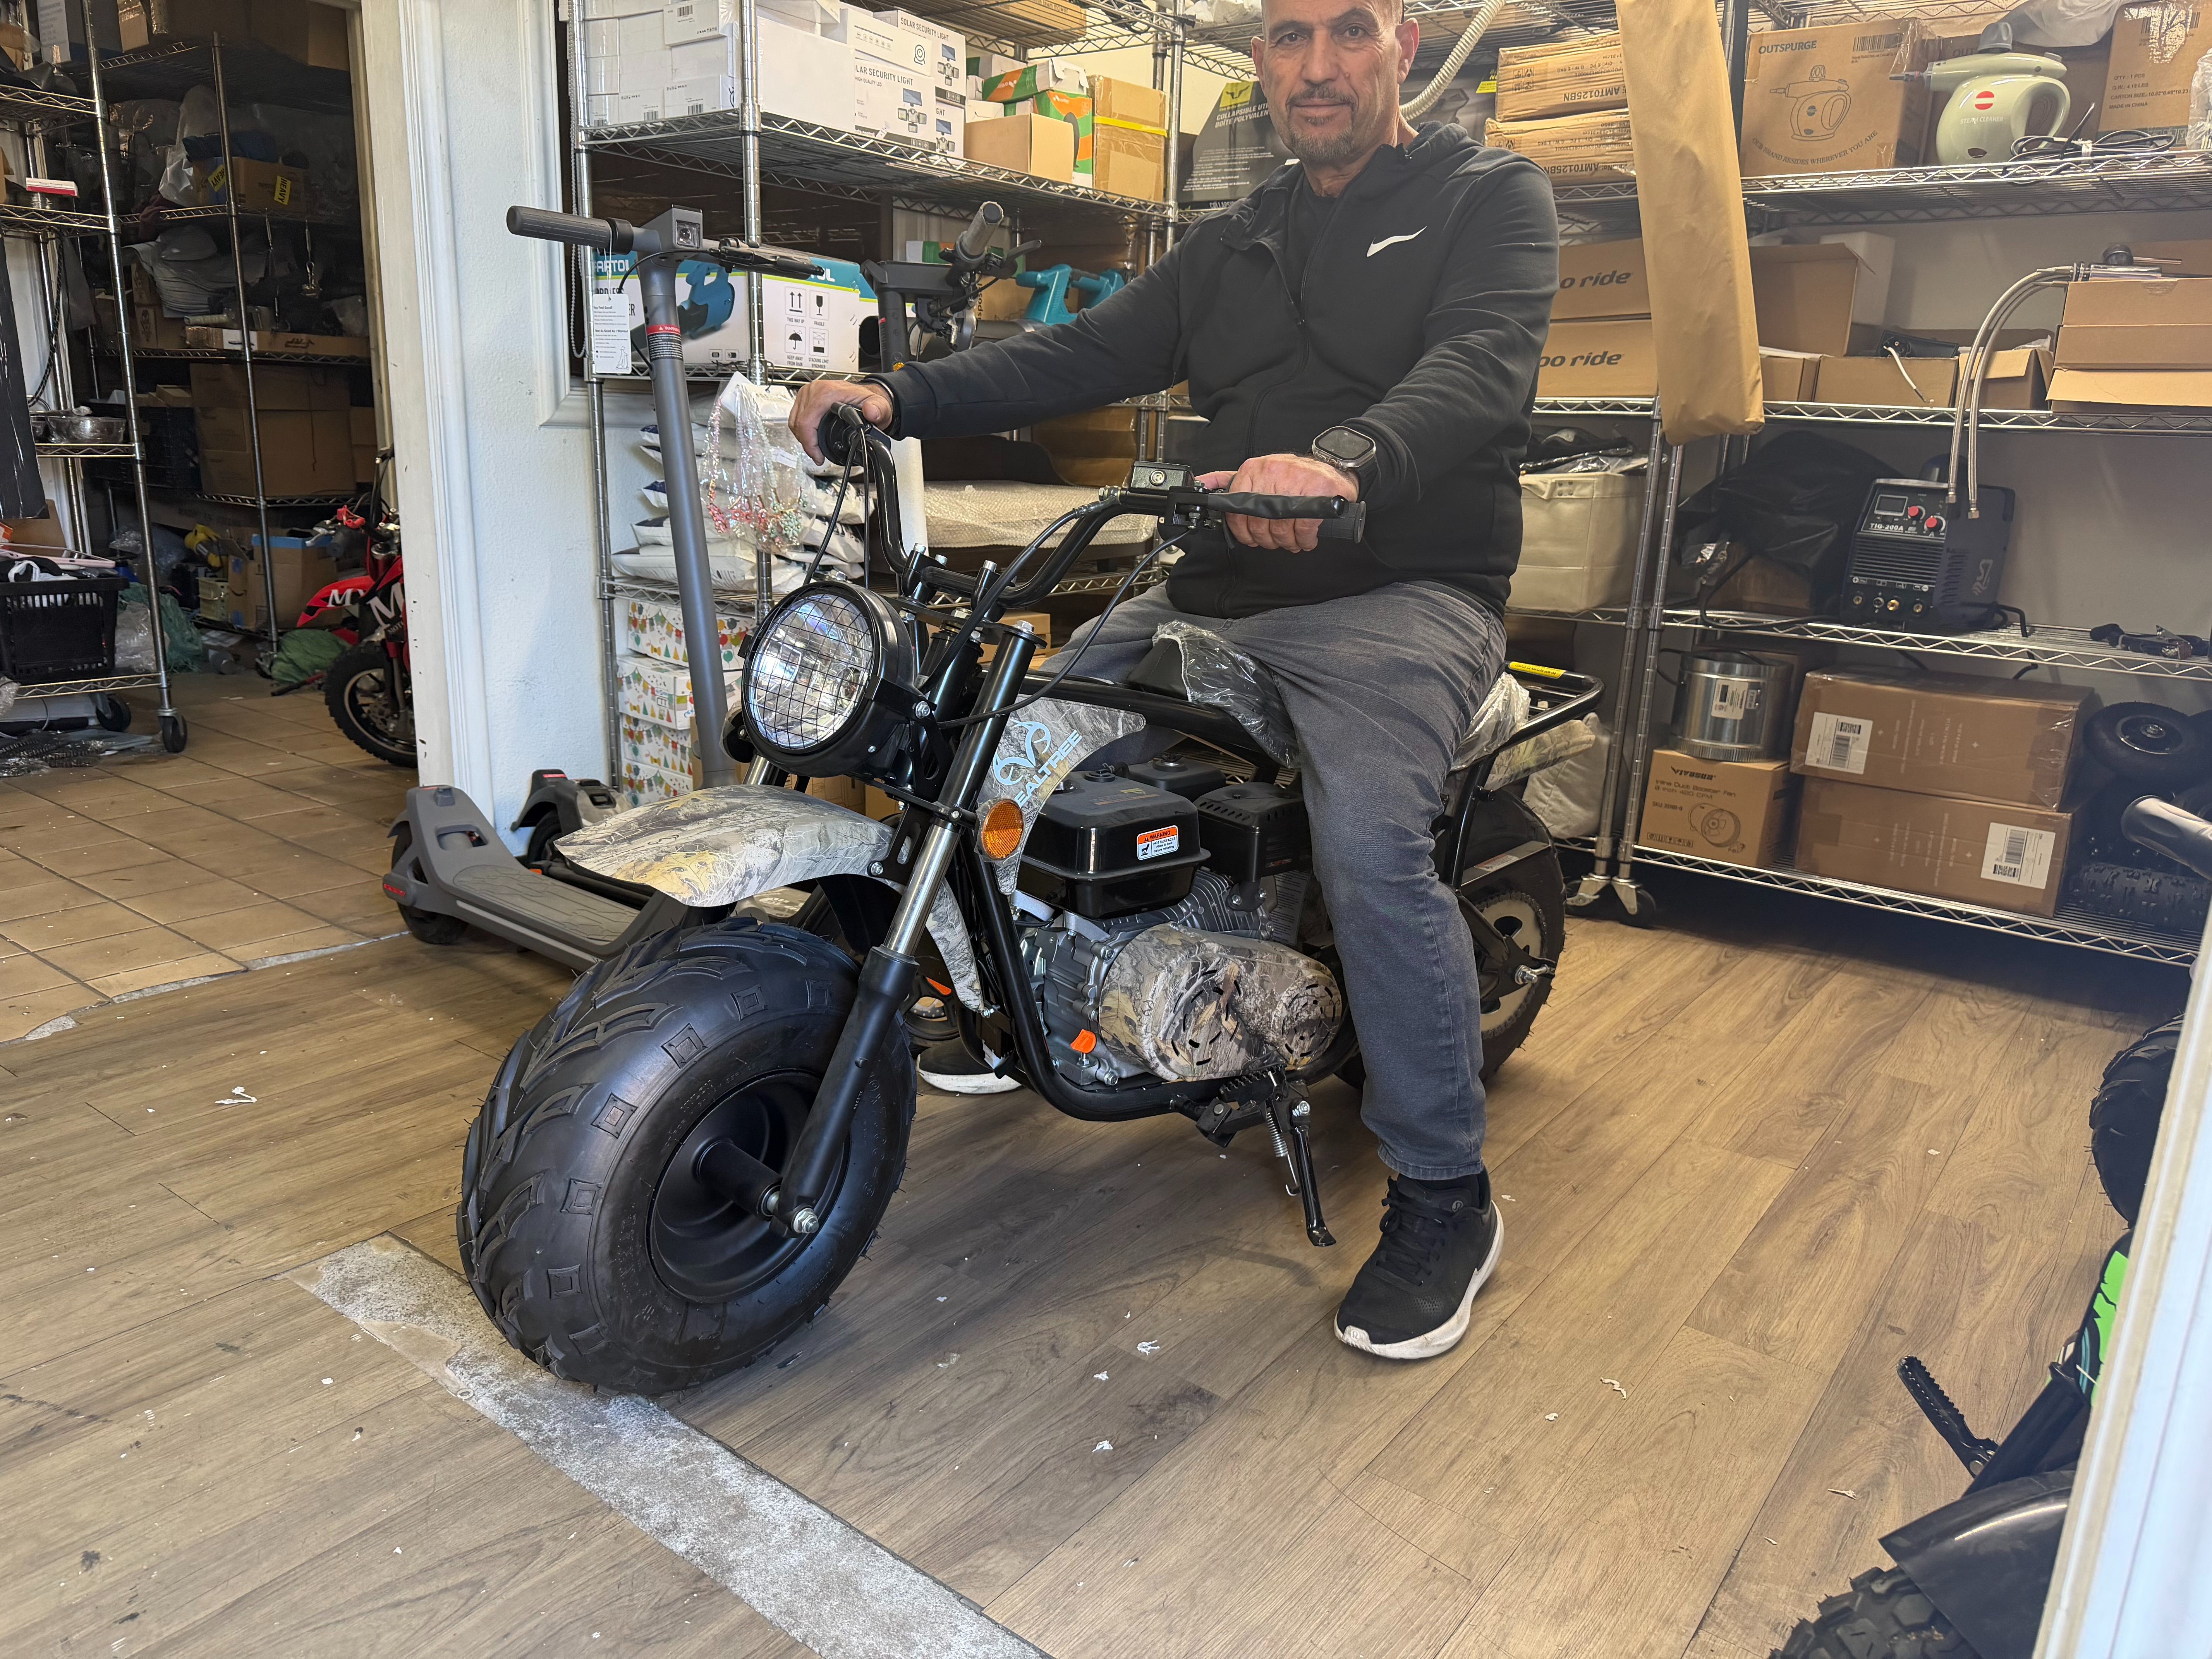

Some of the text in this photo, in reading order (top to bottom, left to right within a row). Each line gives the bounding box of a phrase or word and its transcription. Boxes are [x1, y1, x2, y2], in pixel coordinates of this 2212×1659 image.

[901, 17, 949, 42] SOLAR SECURITY LIGHT
[1758, 40, 1817, 54] OUTSPURGE
[855, 65, 913, 86] LAR SECURITY LIGHT
[1563, 86, 1620, 102] AMT0125BN
[936, 108, 945, 117] GHT
[1216, 105, 1257, 121] COLLAPSIBLE
[1234, 110, 1269, 123] POLYVALEN
[1752, 130, 1878, 165] OUR BRAND RESIDES WHEREVER YOU ARE
[1544, 163, 1599, 173] AMT0125BN
[211, 168, 225, 189] HEAVY
[278, 177, 287, 203] HEAVY
[596, 259, 630, 273] ARTOL
[1579, 270, 1631, 287] ride
[1570, 351, 1623, 367] ride
[1014, 729, 1083, 808] EALTREE
[1674, 781, 1690, 790] Duct
[1692, 785, 1721, 793] Booster
[1149, 830, 1171, 840] WARNING
